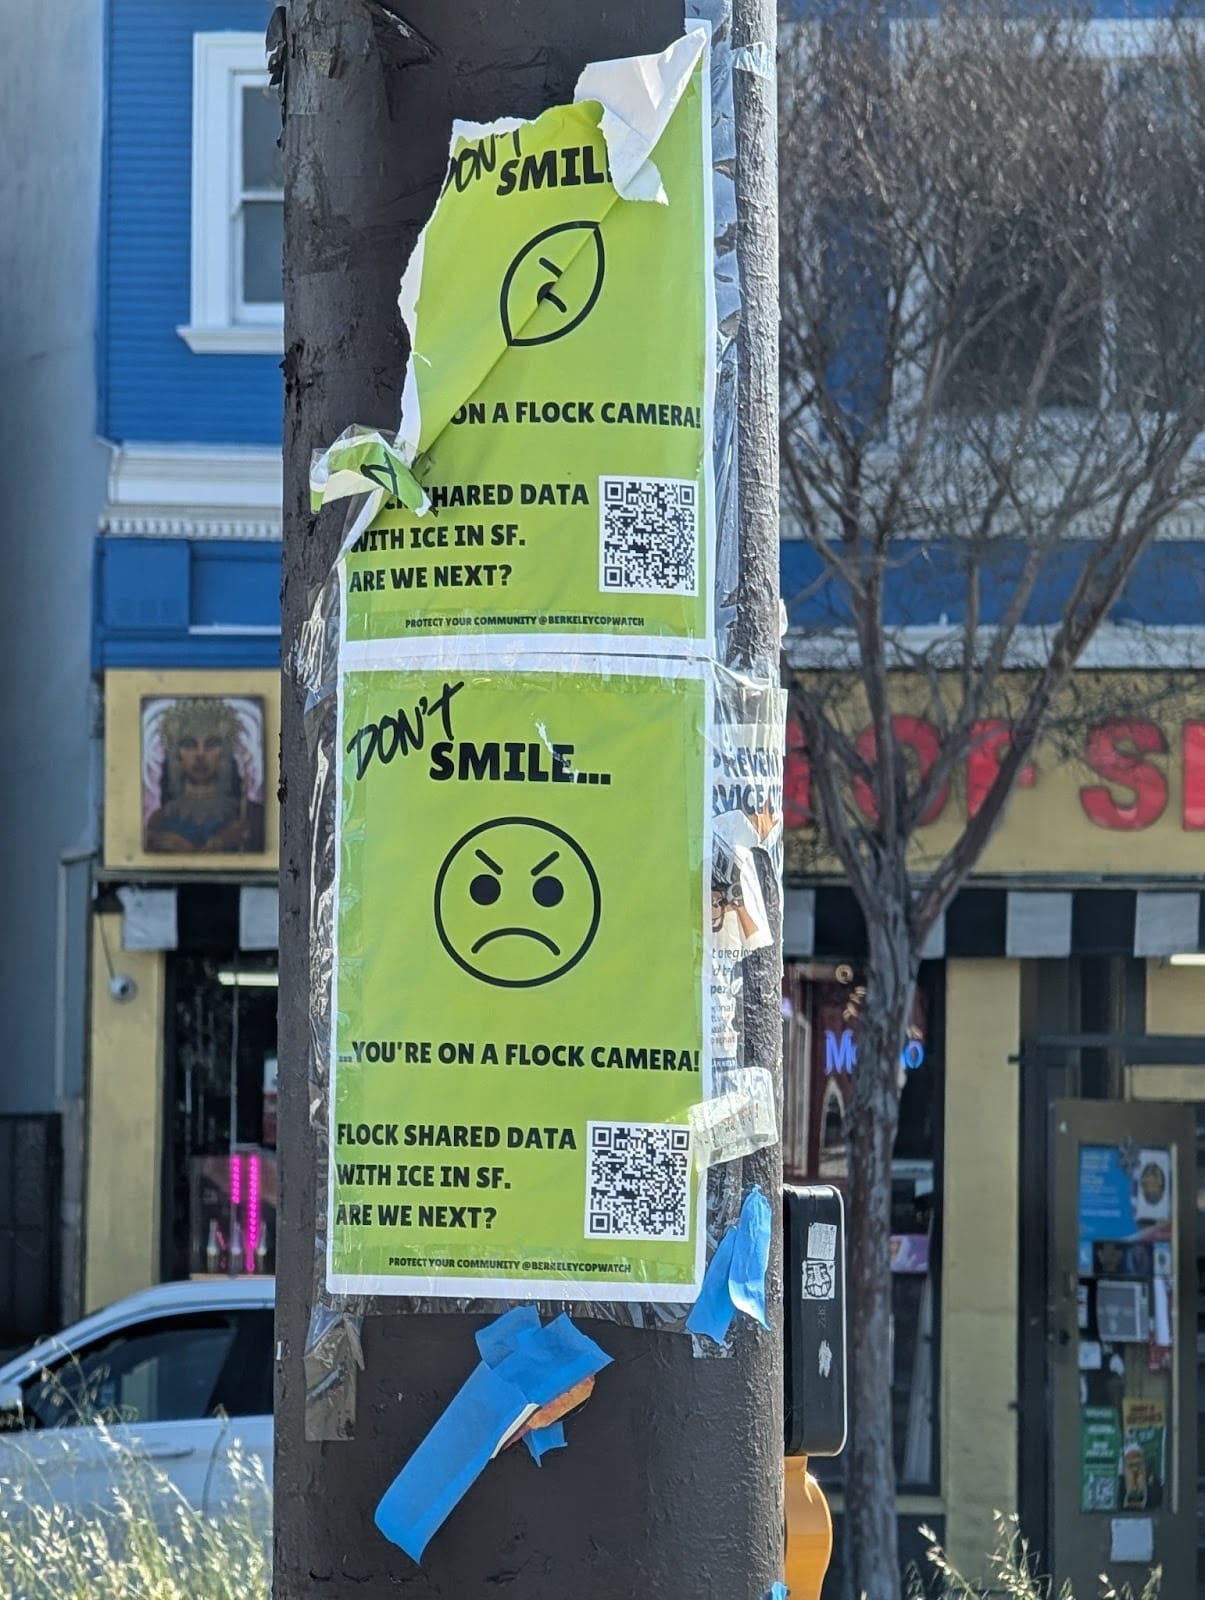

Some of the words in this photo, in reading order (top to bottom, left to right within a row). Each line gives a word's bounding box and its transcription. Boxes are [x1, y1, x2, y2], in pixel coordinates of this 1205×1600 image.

[496, 145, 613, 196] SMIL
[451, 404, 485, 424] ON
[493, 403, 508, 423] A
[517, 402, 594, 422] FLOCK
[601, 403, 700, 427] CAMERA!
[424, 484, 514, 508] HARED
[521, 485, 588, 504] DATA
[411, 527, 448, 548] ICE
[455, 525, 483, 546] IN
[492, 525, 524, 545] SF.
[350, 570, 385, 592] ARE
[391, 568, 427, 588] WE
[435, 565, 511, 586] NEXT?
[406, 619, 443, 627] PROTECT
[475, 617, 536, 625] COMMUNITY
[539, 616, 644, 625] @BERKELEYCOPWATCH
[347, 681, 464, 781] DON'T
[429, 742, 612, 786] SMILE...
[439, 1043, 474, 1064] ON
[481, 1044, 498, 1064] A
[506, 1045, 584, 1066] FLOCK
[591, 1047, 698, 1071] CAMERA!
[338, 1124, 398, 1145] FLOCK
[405, 1125, 500, 1147] SHARED
[508, 1128, 576, 1149] DATA
[338, 1165, 390, 1185] WITH
[397, 1166, 434, 1186] ICE
[441, 1167, 469, 1187] IN
[477, 1167, 510, 1188] SF.
[337, 1205, 372, 1225] ARE
[379, 1205, 411, 1225] WE
[419, 1206, 496, 1228] NEXT?
[389, 1258, 426, 1266] PROTECT
[429, 1259, 454, 1267] YOUR
[457, 1260, 519, 1268] COMMUNITY
